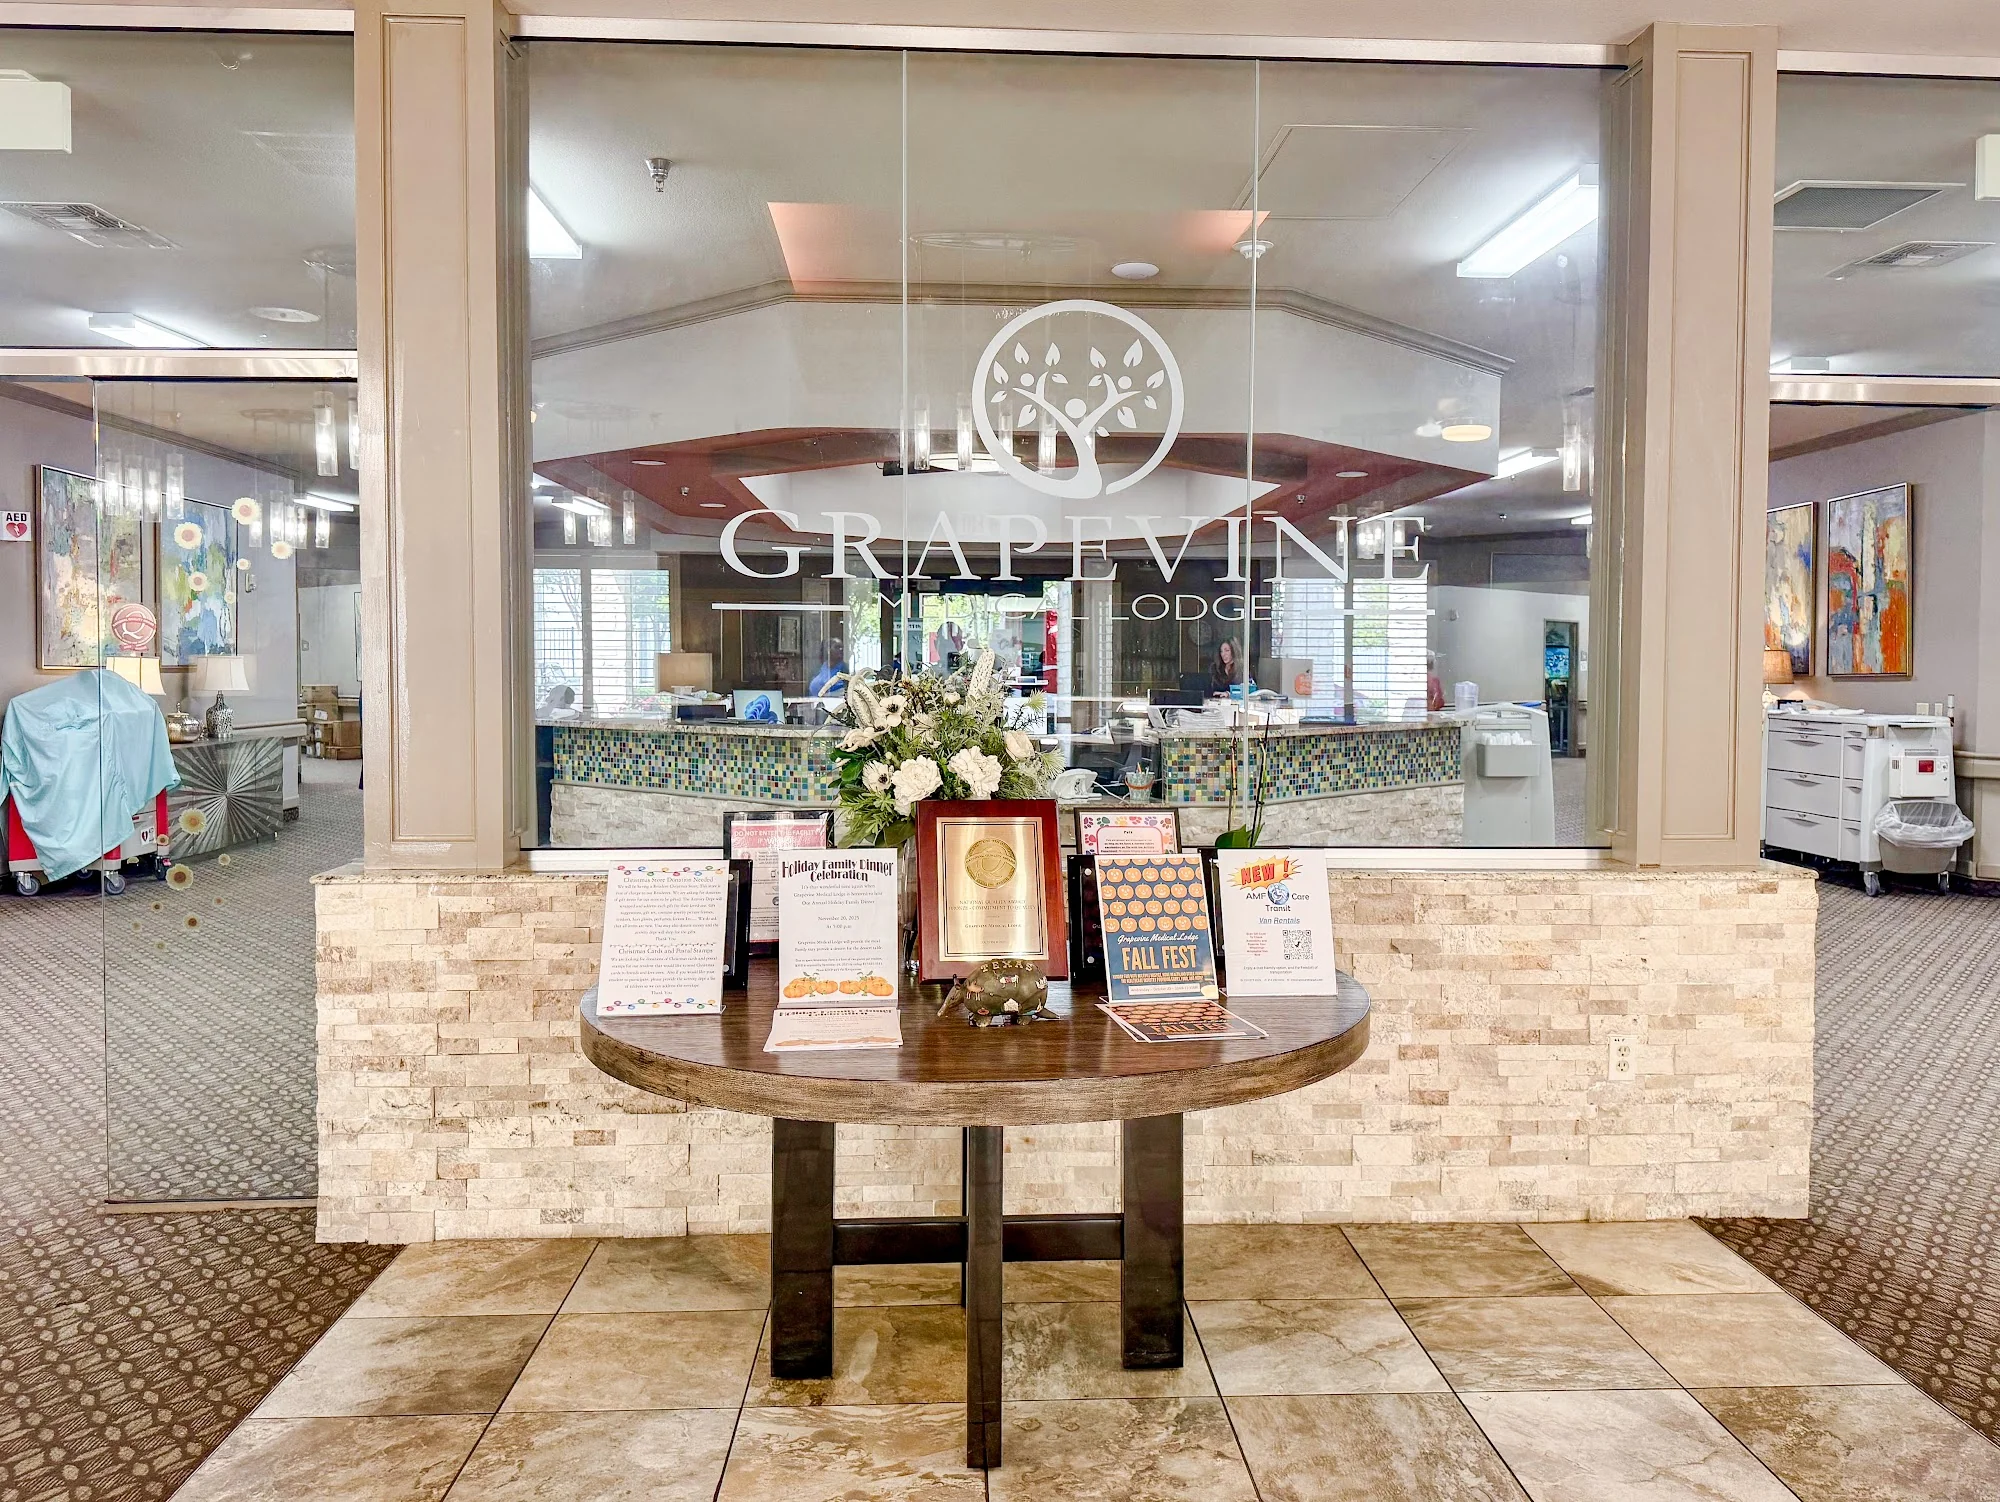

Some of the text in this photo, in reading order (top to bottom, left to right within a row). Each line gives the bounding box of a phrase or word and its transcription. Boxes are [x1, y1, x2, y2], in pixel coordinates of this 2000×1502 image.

[6, 512, 26, 522] AED
[719, 508, 1430, 583] GRAPEVINE
[877, 592, 1271, 621] MEDICAL LODGE
[782, 859, 894, 878] Holiday Family Dinner
[810, 870, 868, 882] Celebration
[1241, 863, 1275, 885] NEW
[1118, 933, 1199, 944] Grapevine Medical Lodge
[1122, 945, 1197, 970] FALL FEST
[980, 960, 1034, 972] TEXAS
[1150, 1025, 1197, 1034] FALL
